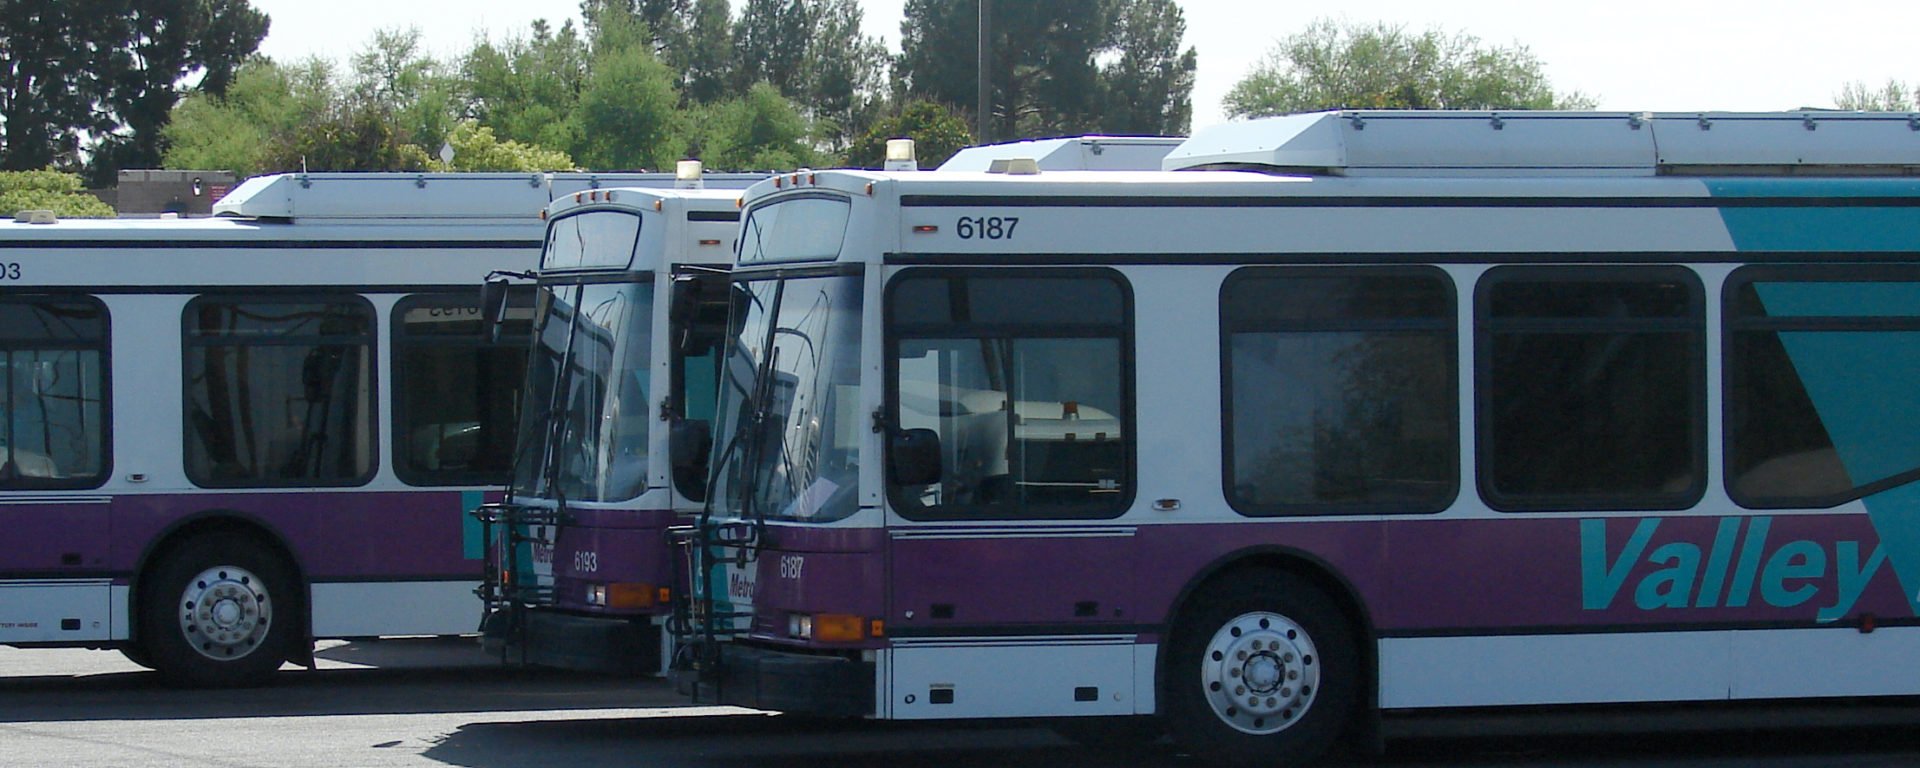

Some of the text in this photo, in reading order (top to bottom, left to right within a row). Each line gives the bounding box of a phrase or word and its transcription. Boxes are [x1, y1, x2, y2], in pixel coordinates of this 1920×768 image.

[957, 216, 1019, 240] 6187
[574, 550, 597, 572] 6193
[780, 555, 804, 579] 6187
[1579, 515, 1885, 624] Valley
[729, 572, 754, 598] Metro
